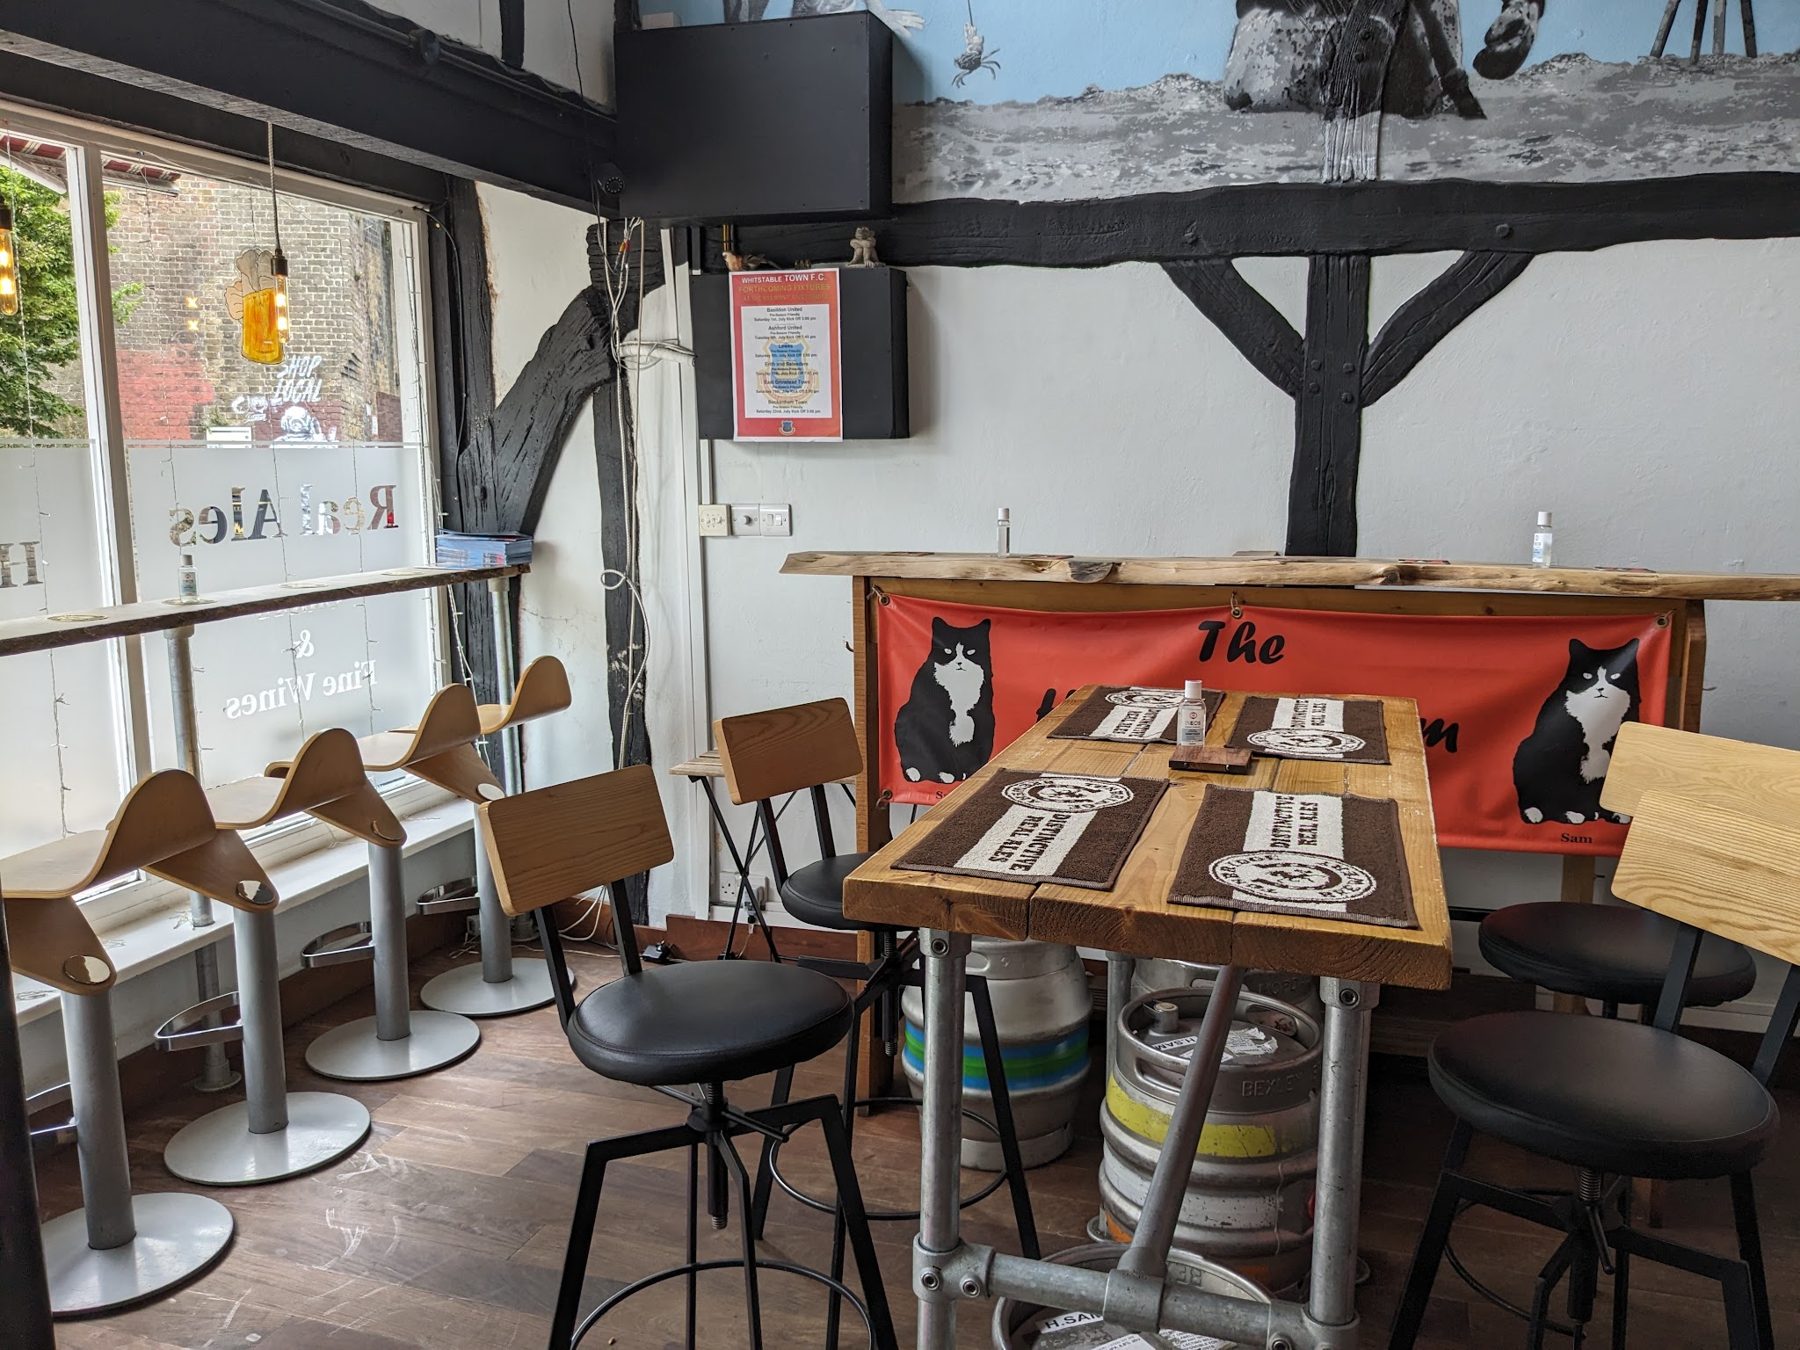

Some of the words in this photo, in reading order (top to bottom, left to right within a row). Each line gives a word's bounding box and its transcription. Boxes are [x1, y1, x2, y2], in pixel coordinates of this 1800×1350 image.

[742, 276, 783, 284] WHITSTABLE
[785, 274, 809, 282] TOWN
[273, 377, 322, 403] LOCAL
[1198, 620, 1285, 665] The
[1270, 795, 1295, 849] DISTINCTIVE
[1300, 801, 1319, 822] ALES
[1010, 815, 1045, 838] REAL
[1298, 822, 1318, 847] REAL
[1560, 832, 1593, 845] Sam
[988, 838, 1021, 863] ALES
[1009, 813, 1072, 872] DISTINCTIVE
